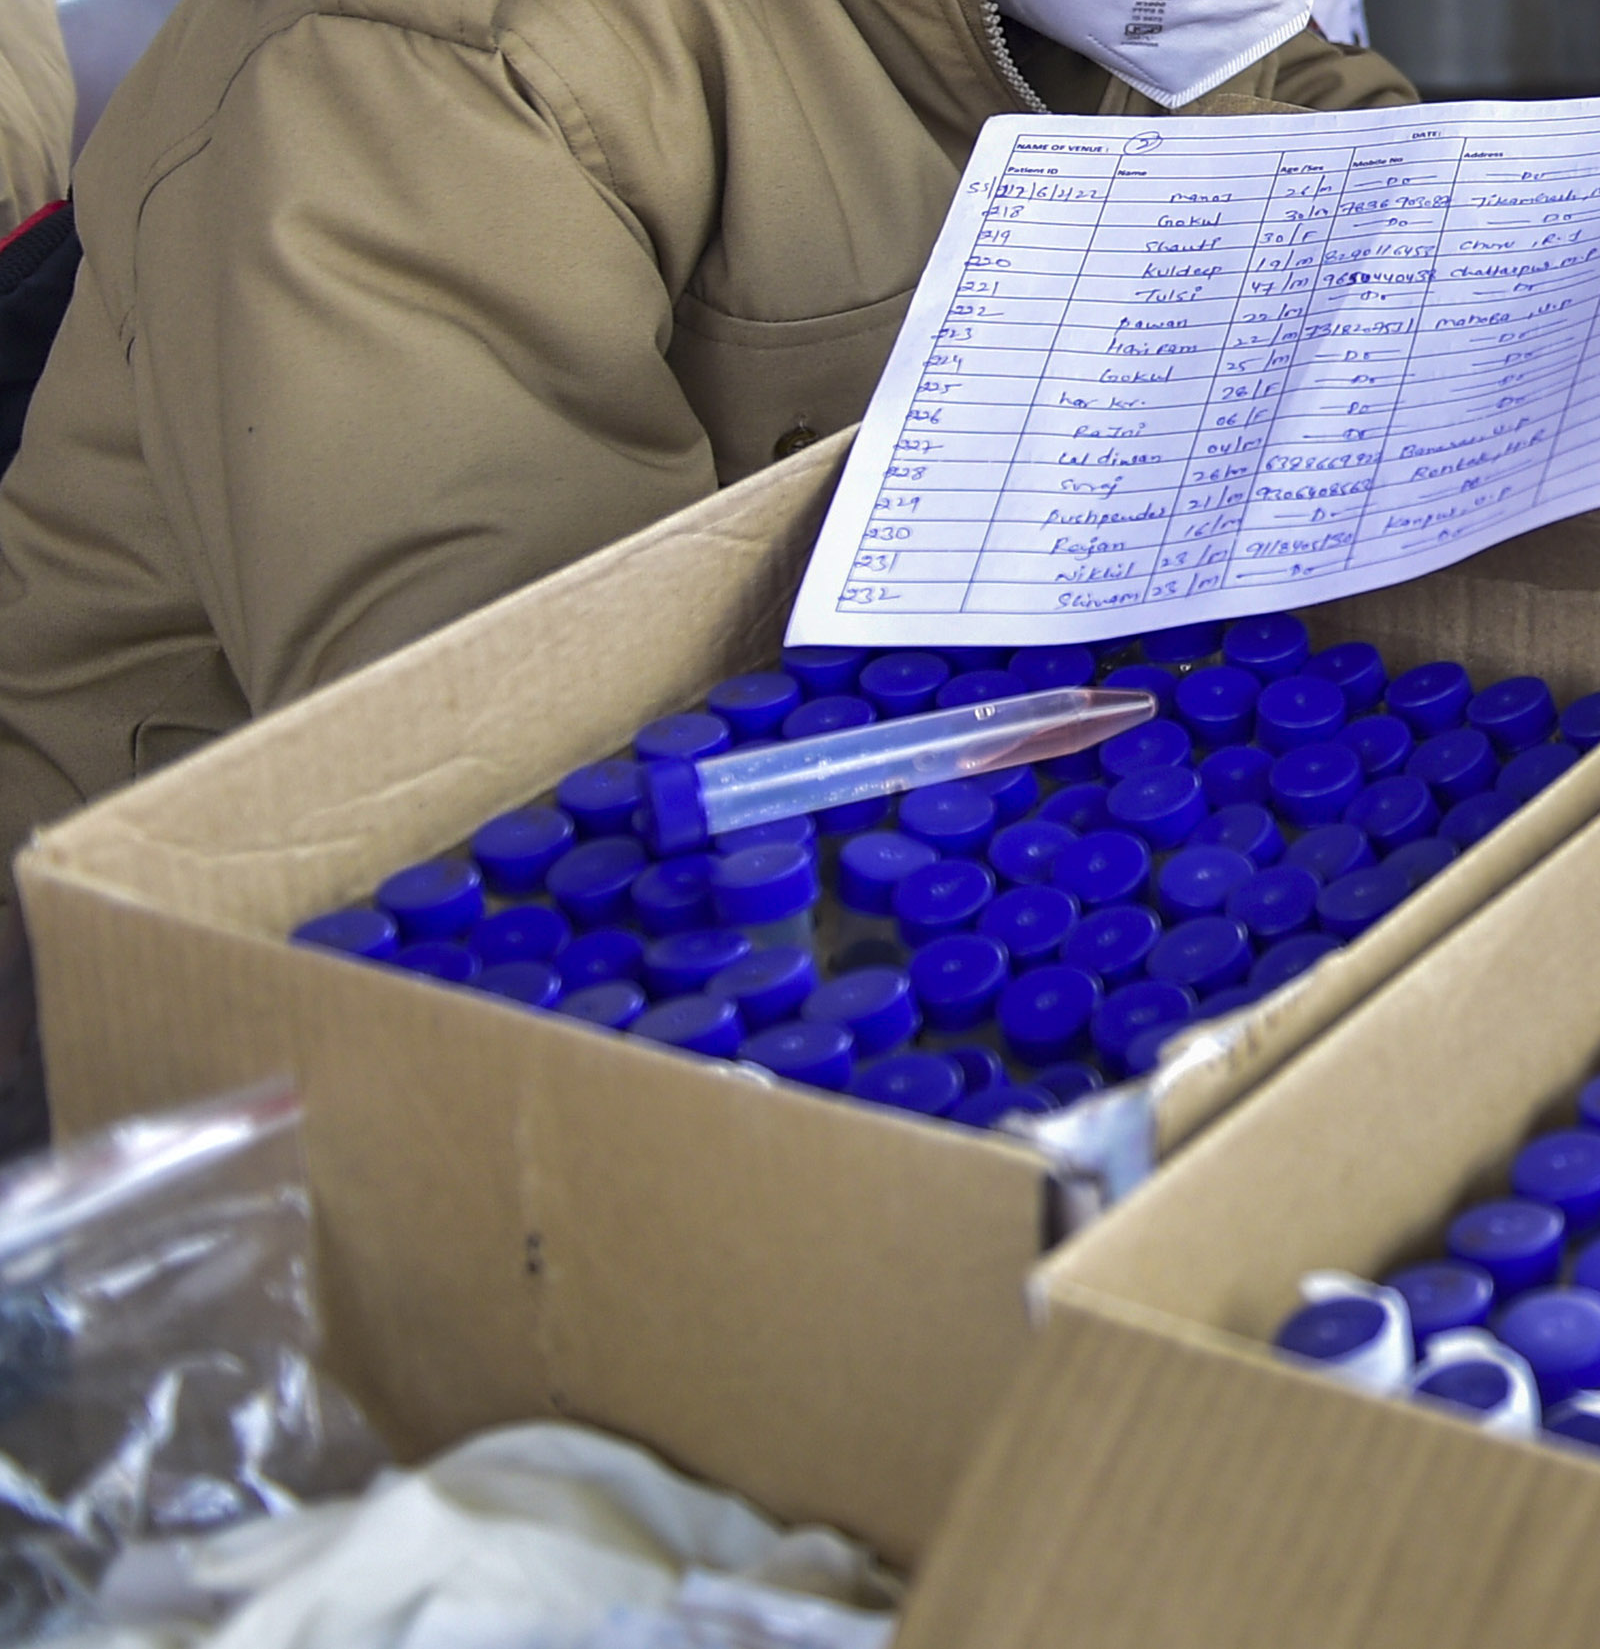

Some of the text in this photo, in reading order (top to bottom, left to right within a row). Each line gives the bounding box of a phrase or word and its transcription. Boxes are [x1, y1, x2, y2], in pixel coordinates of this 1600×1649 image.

[1412, 131, 1441, 139] DATE:
[1017, 143, 1048, 151] NAME
[1353, 157, 1403, 168] Mobile No
[1008, 166, 1044, 174] Patient
[1281, 167, 1299, 175] Age
